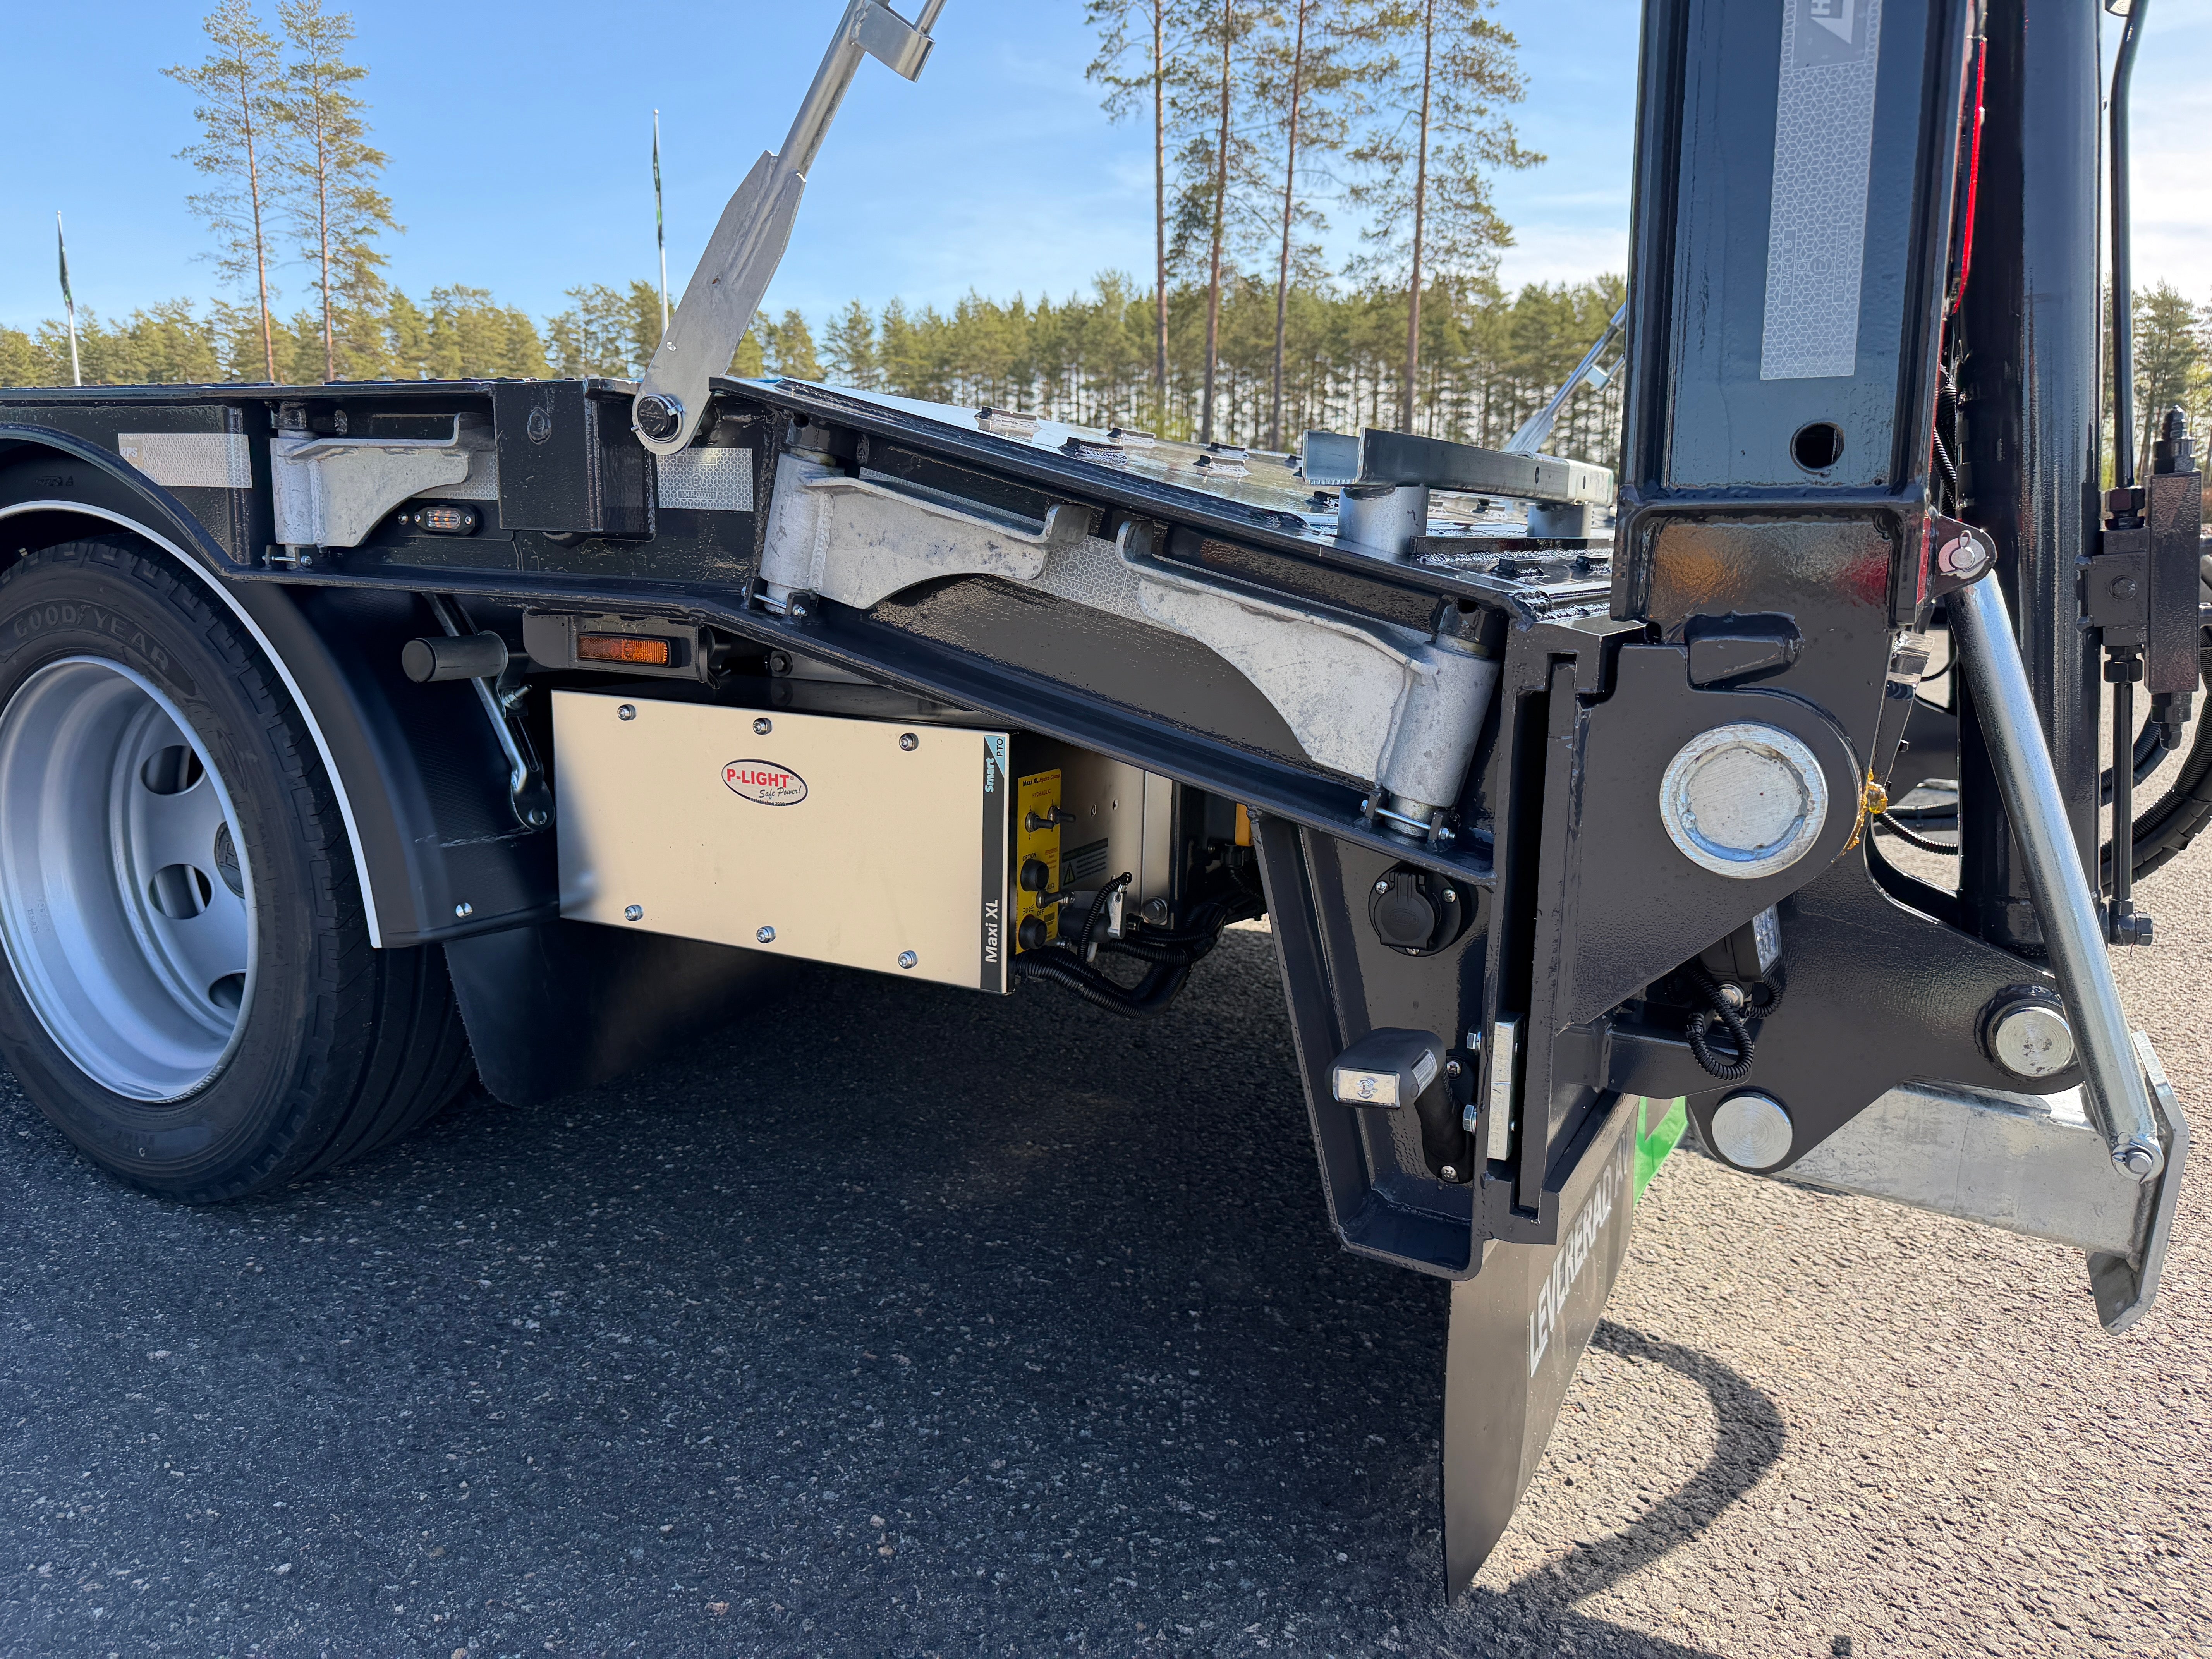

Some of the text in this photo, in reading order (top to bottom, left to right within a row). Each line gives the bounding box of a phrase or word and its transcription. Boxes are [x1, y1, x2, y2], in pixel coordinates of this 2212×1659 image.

[1048, 574, 1059, 583] 104
[759, 785, 802, 799] Safe Power!
[985, 757, 994, 793] Smart
[985, 900, 998, 963] Maxi XL
[1530, 1165, 1612, 1377] LEVERERAD
